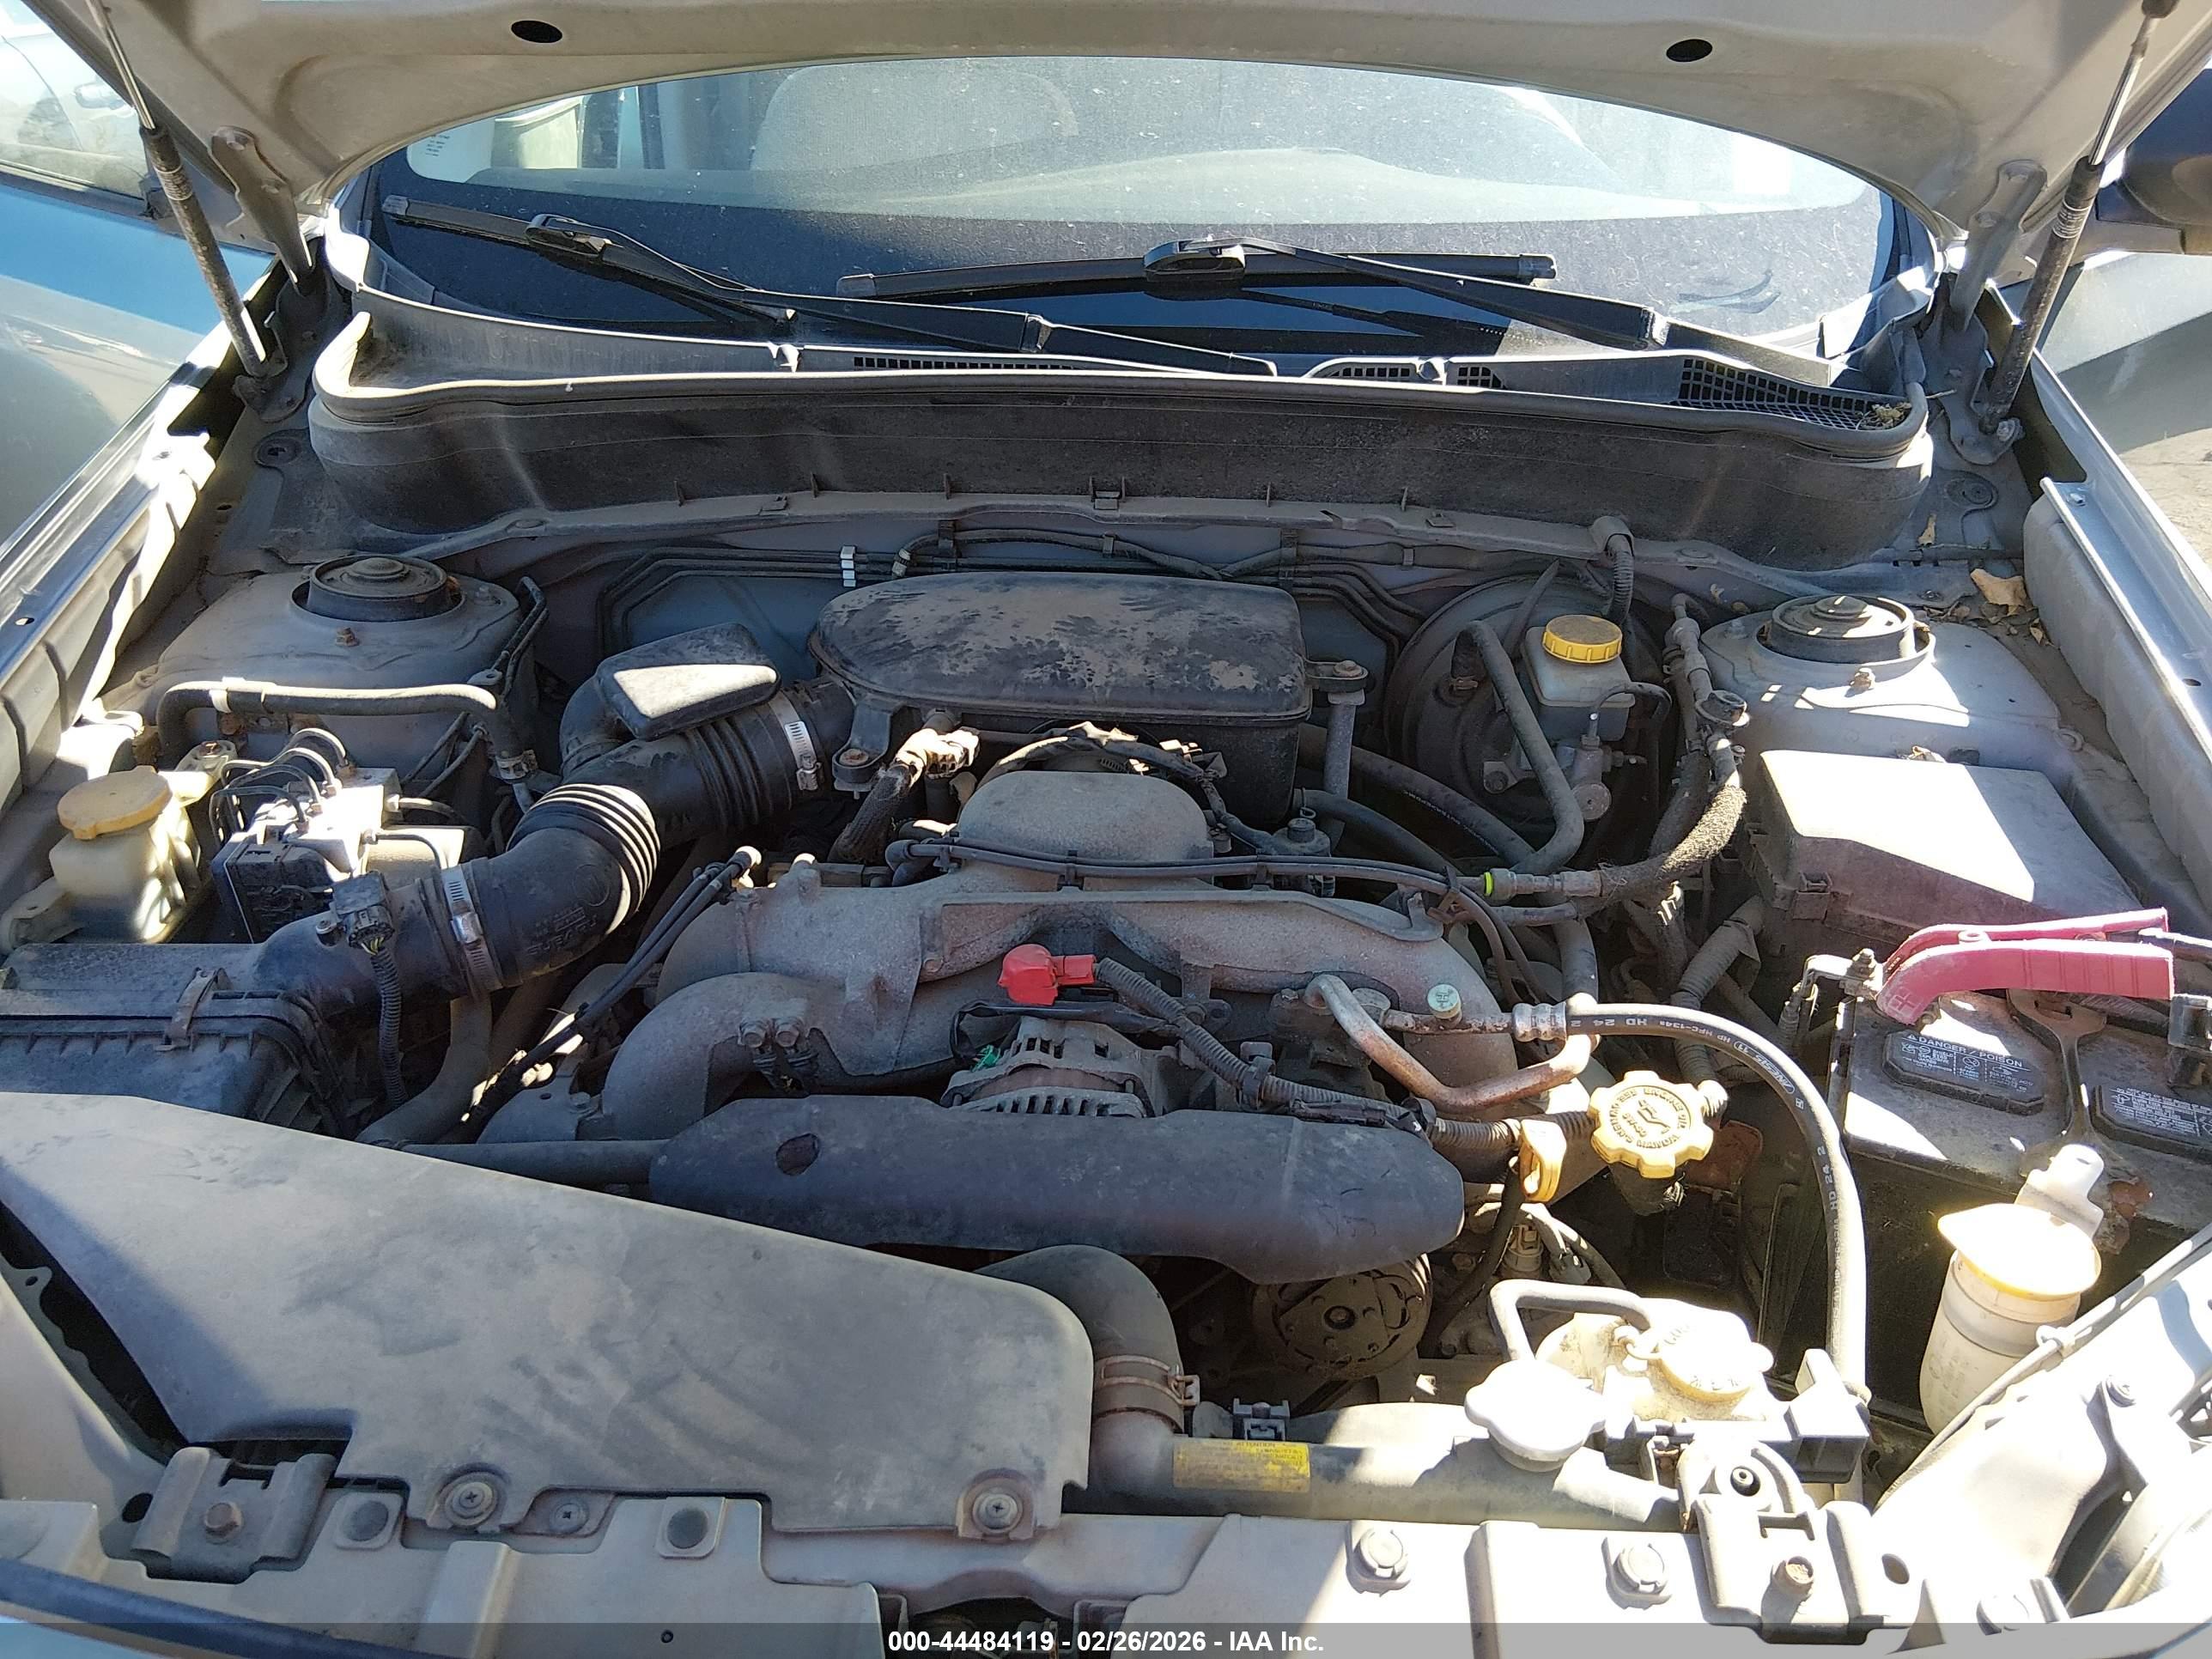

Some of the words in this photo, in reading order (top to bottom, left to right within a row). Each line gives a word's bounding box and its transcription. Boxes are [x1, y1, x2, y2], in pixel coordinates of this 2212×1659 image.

[1659, 1020, 1713, 1036] HFC-134a
[1717, 1035, 1730, 1043] HP
[1918, 1036, 1966, 1054] DANGER
[1979, 1052, 2023, 1067] POISON
[1817, 1146, 1826, 1156] 2
[1824, 1165, 1833, 1184] 24
[1829, 1190, 1838, 1211] HD
